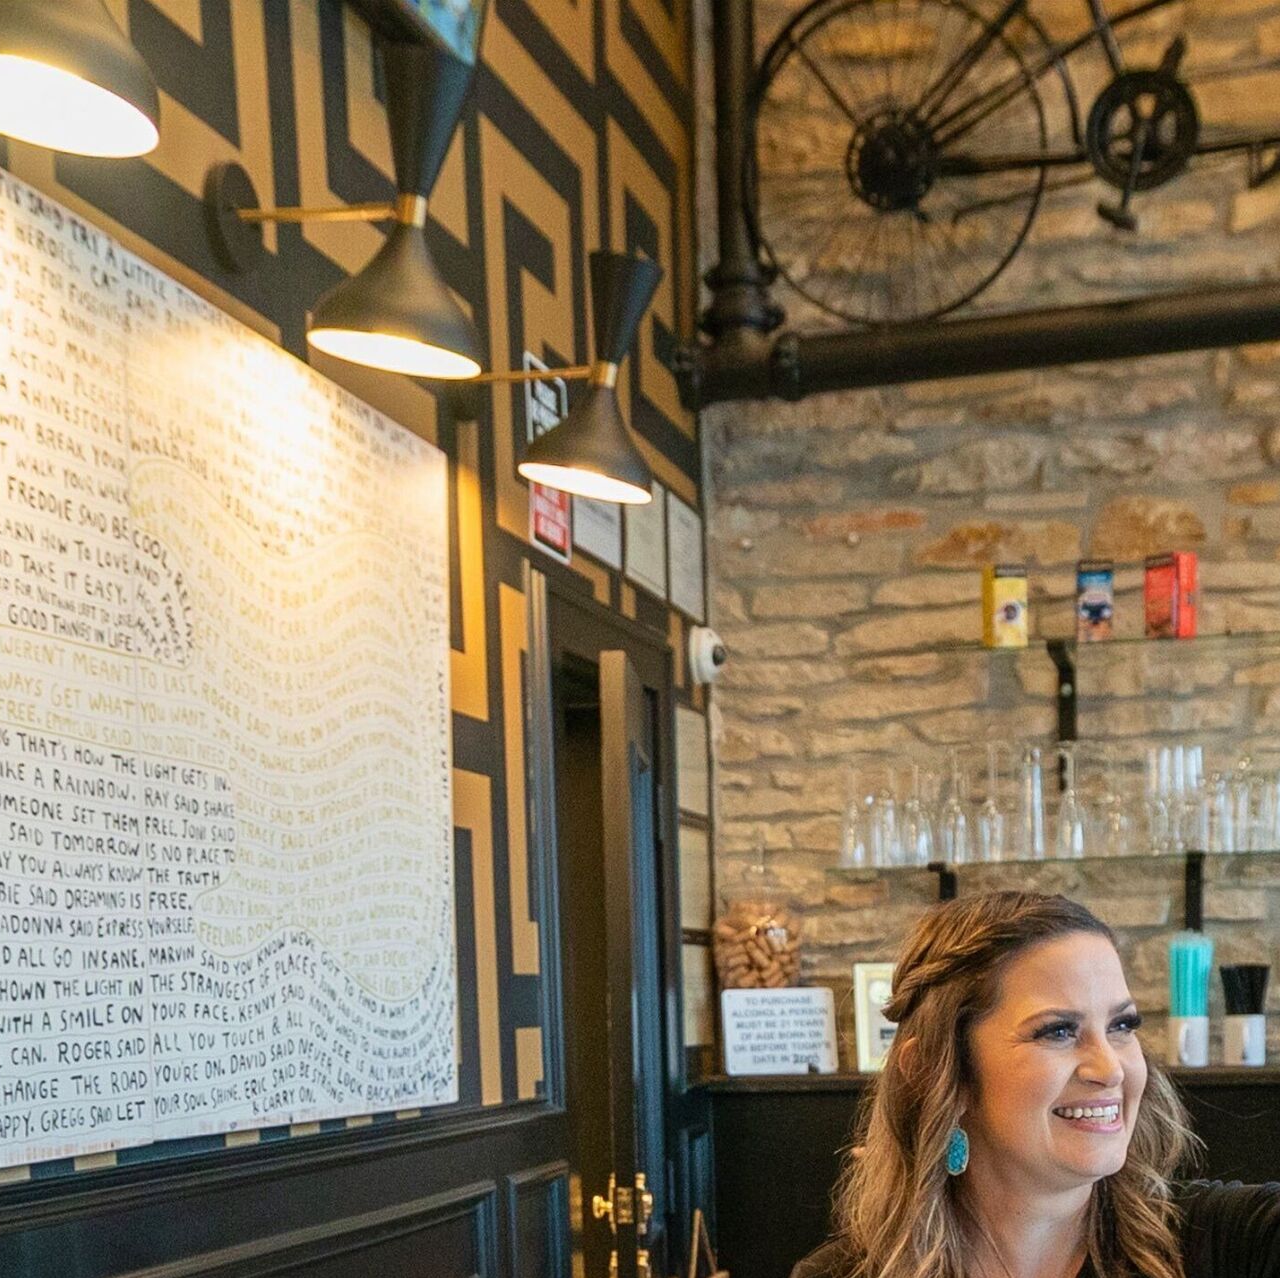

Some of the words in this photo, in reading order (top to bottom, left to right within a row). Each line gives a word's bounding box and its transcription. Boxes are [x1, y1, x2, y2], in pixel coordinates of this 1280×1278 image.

[7, 474, 72, 522] FREDDIE
[78, 503, 106, 534] SAID
[111, 515, 128, 540] BE
[15, 731, 66, 760] THAT'S
[73, 747, 104, 766] HOW
[110, 752, 136, 775] THE
[143, 761, 177, 779] LIGHT
[180, 767, 207, 785] GETS
[52, 767, 136, 800] RAINBOW.
[143, 789, 167, 807] RAY
[174, 793, 199, 815] SAID
[203, 799, 234, 819] SHAKE
[52, 978, 79, 998] THE
[84, 978, 122, 997] LIGHT
[128, 979, 143, 996] IN
[149, 972, 174, 992] THE
[180, 969, 255, 1001] STRANGEST
[60, 1003, 114, 1031] SMILE
[120, 1005, 142, 1024] ON
[151, 1001, 186, 1021] YOUR
[193, 1002, 234, 1023] FACE.
[10, 1046, 46, 1066] CAN.
[70, 1073, 101, 1095] THE
[110, 1069, 148, 1093] ROAD
